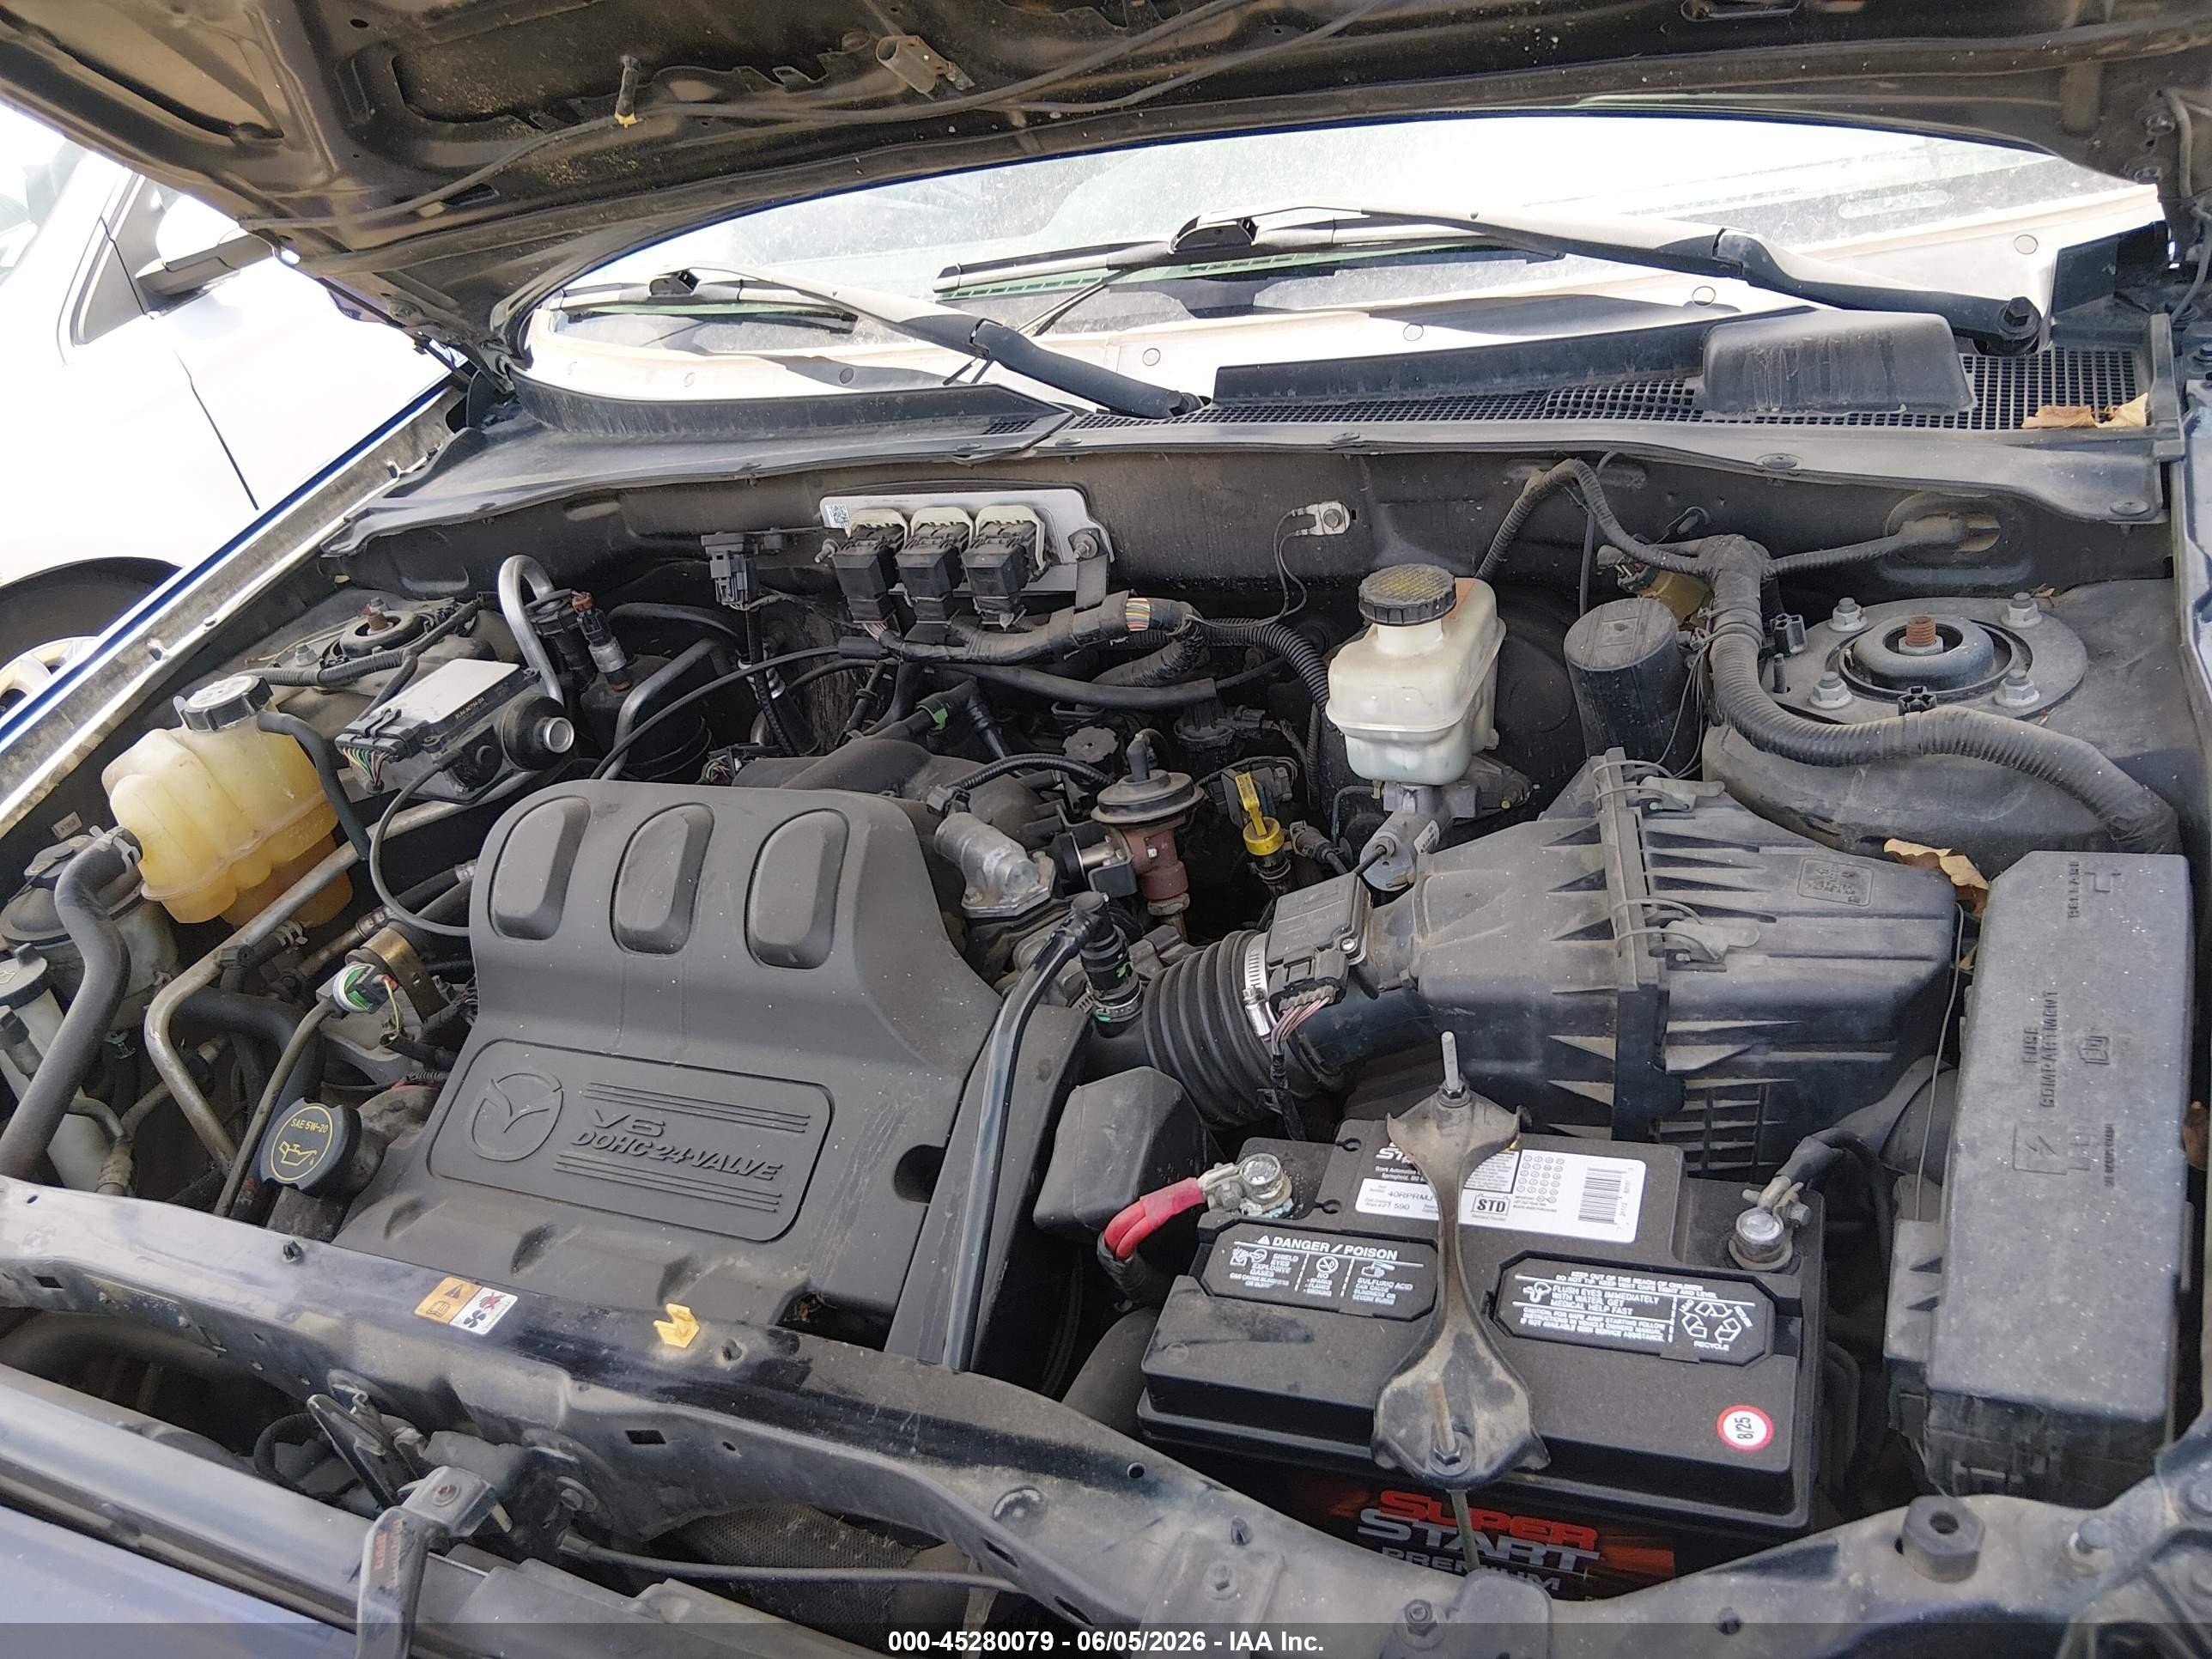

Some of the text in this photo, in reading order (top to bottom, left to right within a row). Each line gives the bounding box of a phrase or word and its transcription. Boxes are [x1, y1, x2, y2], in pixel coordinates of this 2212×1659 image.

[2022, 1027, 2039, 1064] FUSE
[2039, 990, 2058, 1108] COMPARTMENT
[290, 1118, 329, 1133] SAE 5W-20
[589, 1108, 665, 1138] V6
[570, 1130, 784, 1181] DOHC 24-VALVE
[1477, 1198, 1506, 1213] STD
[1394, 1282, 1413, 1291] ACID
[1553, 1285, 1659, 1304] FLUSH EYES IMMEDIATELY
[1550, 1299, 1633, 1316] MEDICAL HELP FAST
[1552, 1291, 1572, 1301] WITH
[1607, 1298, 1624, 1307] GET
[1693, 1340, 1729, 1351] RECYCLE
[1735, 1417, 1754, 1439] 8/25
[1380, 1490, 1599, 1552] SUPER
[1357, 1508, 1601, 1571] START
